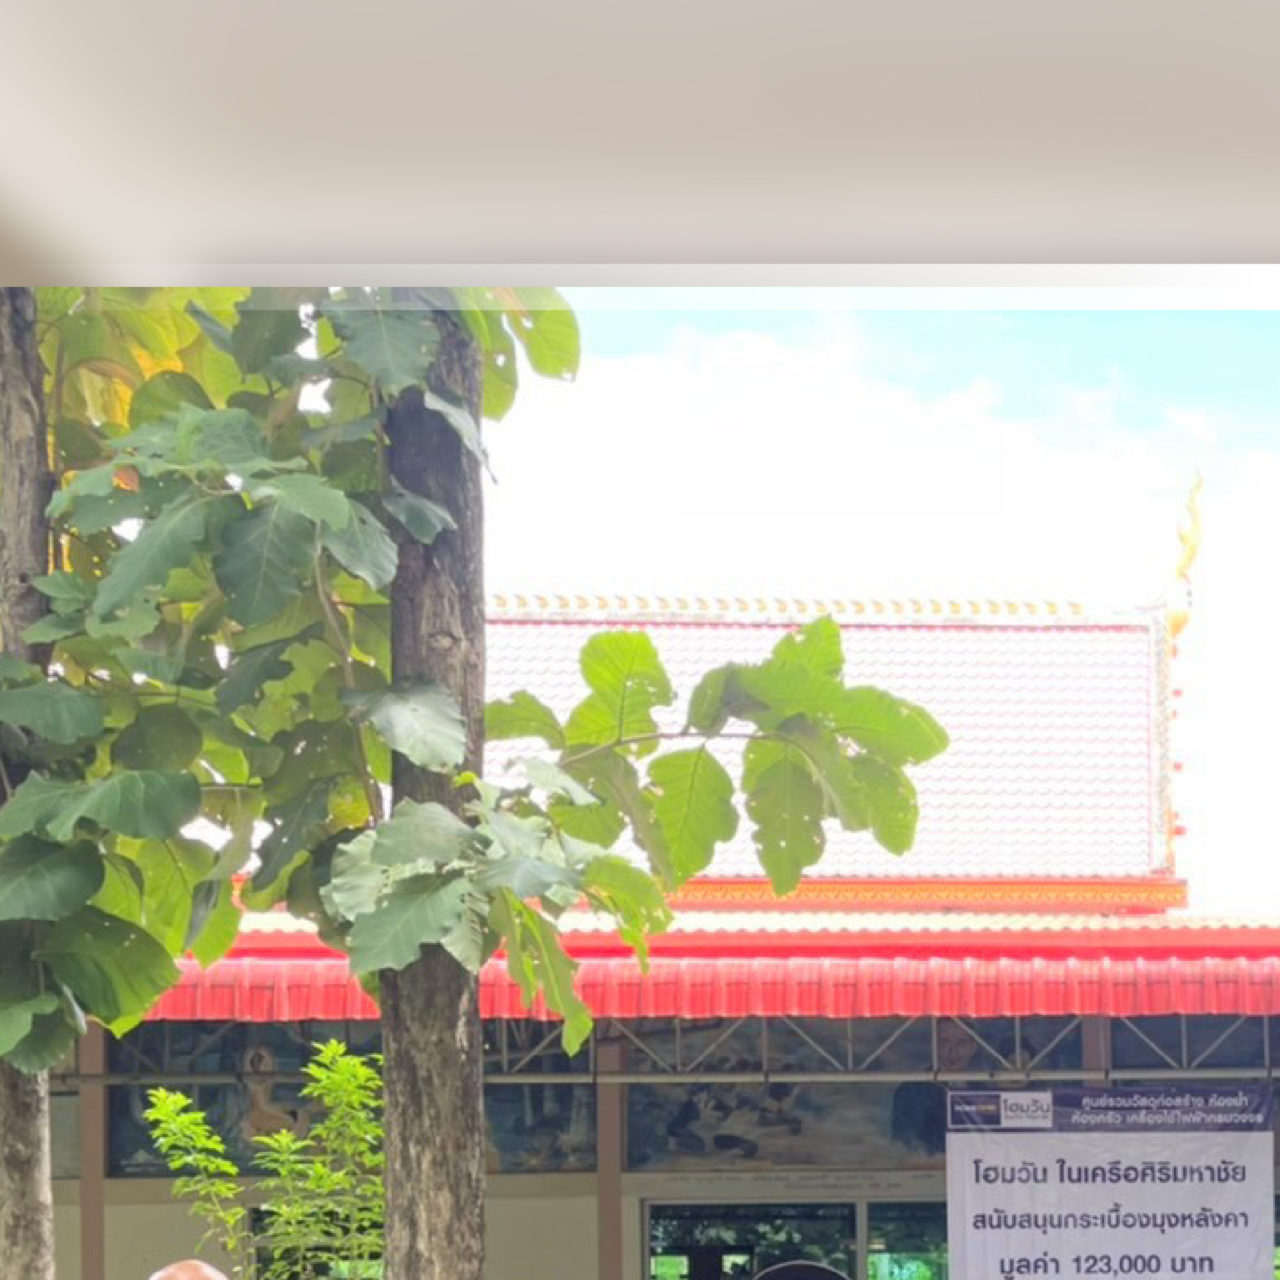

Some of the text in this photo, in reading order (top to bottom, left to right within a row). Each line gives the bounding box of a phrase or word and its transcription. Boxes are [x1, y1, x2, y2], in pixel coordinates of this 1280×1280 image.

[973, 1158, 1246, 1184] โฮมวัน ในเครือศิริมหาชัย
[972, 1203, 1249, 1235] สนับสนุนกระเบื้องมุงหลังคา
[999, 1252, 1214, 1280] มูลค่า 123,000 บาท
